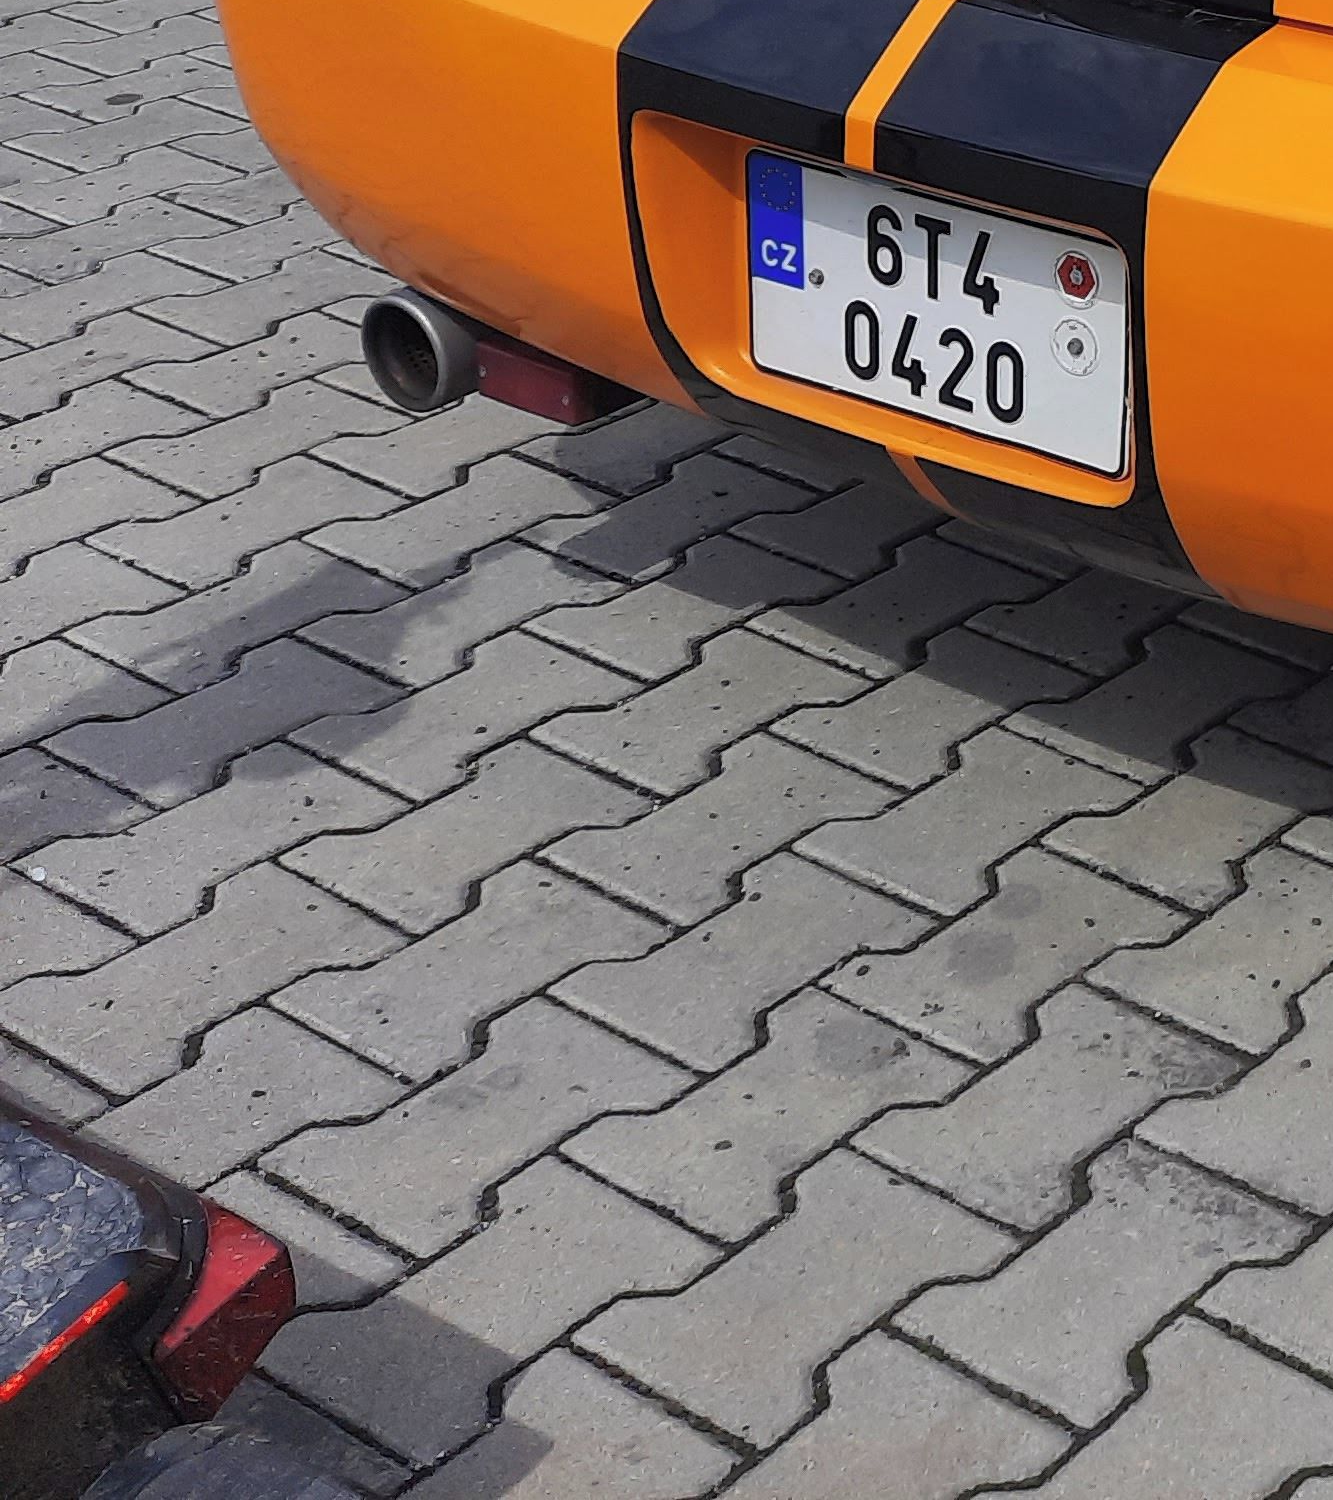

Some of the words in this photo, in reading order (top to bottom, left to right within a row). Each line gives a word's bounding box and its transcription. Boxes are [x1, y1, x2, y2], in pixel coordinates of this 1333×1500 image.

[761, 238, 798, 274] CZ
[867, 204, 1001, 315] 6T4
[845, 300, 1025, 424] 0420
